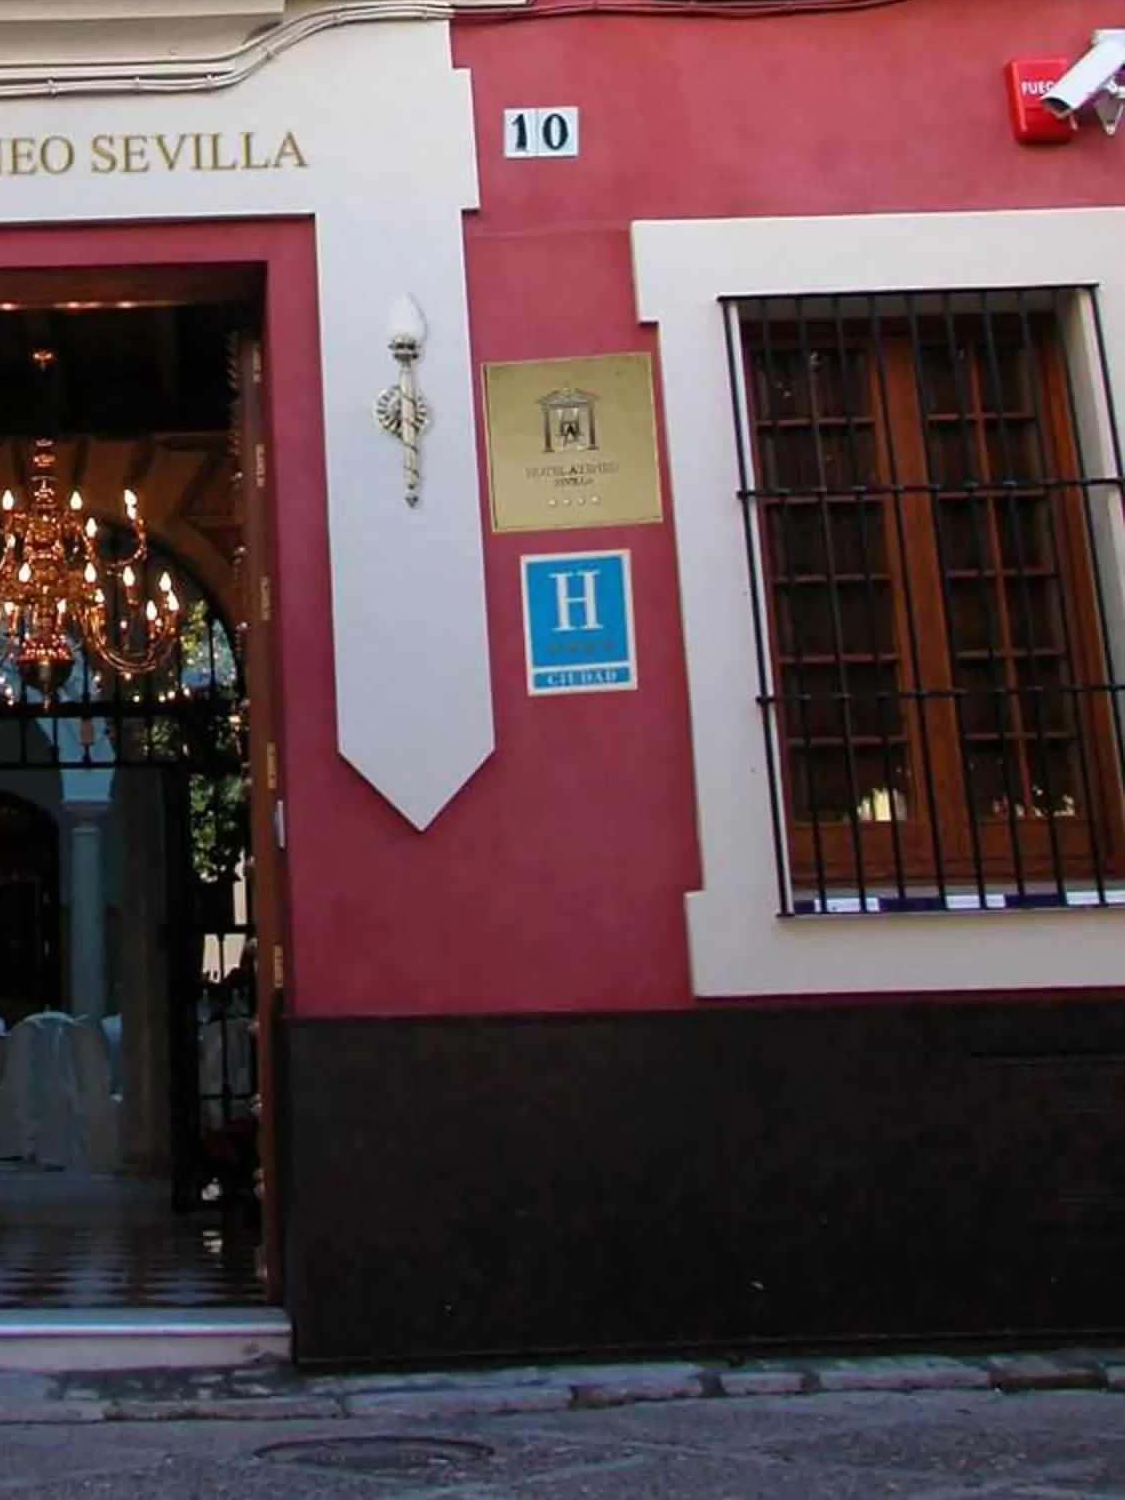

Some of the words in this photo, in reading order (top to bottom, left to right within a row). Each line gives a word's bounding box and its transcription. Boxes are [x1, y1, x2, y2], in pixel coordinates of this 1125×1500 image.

[90, 131, 309, 174] SEVILLA
[511, 113, 569, 152] 10
[549, 568, 605, 631] H
